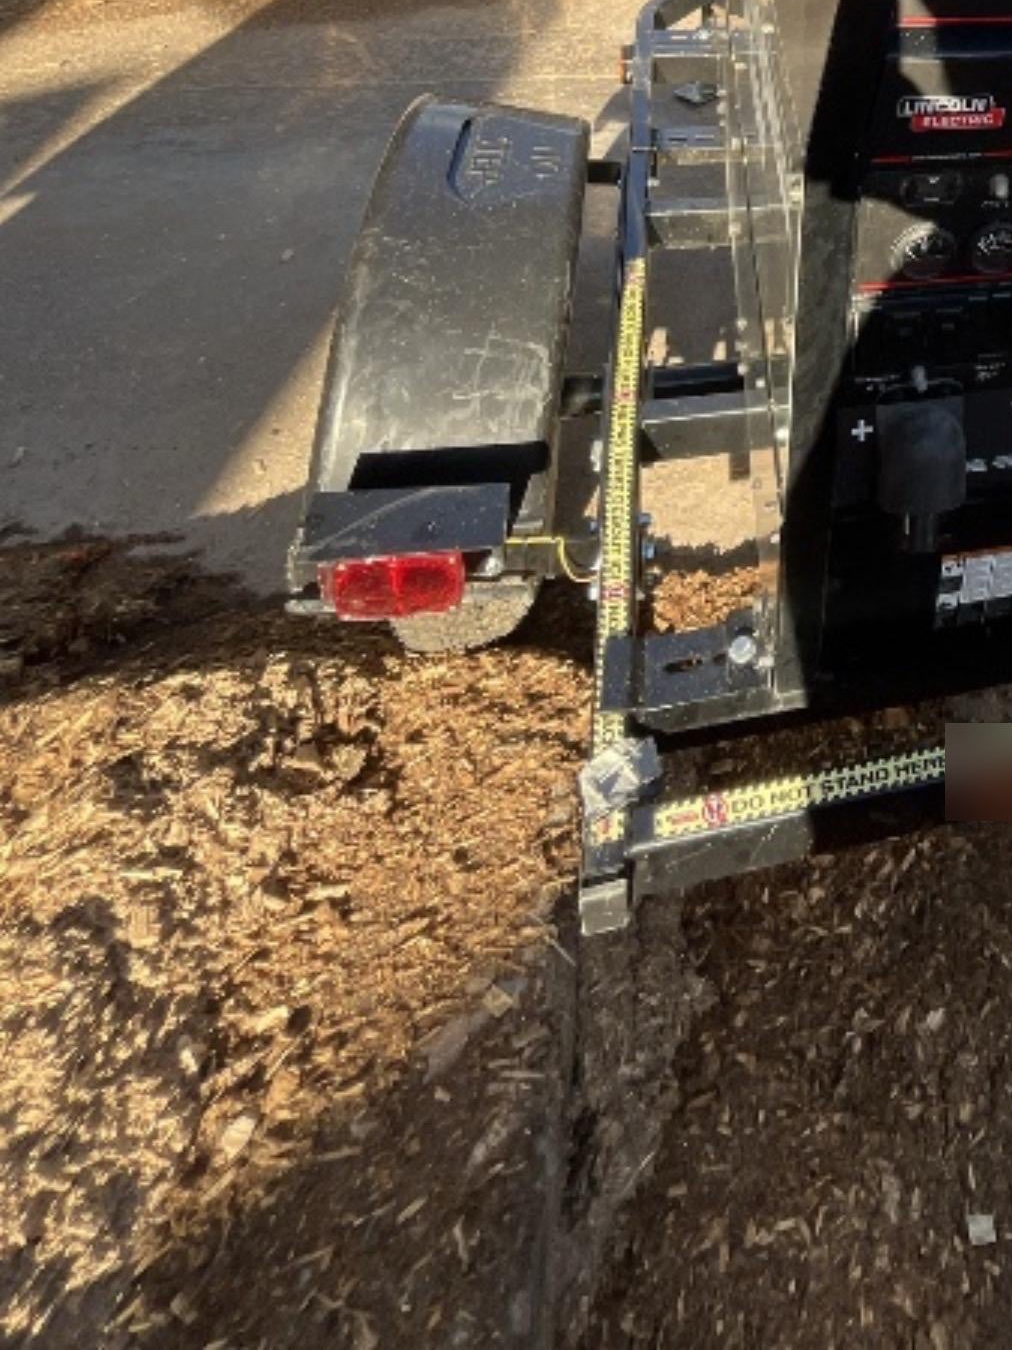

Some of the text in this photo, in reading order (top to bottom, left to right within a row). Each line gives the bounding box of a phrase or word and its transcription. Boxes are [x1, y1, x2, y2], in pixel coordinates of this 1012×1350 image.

[904, 97, 989, 115] LINCOLN
[922, 113, 994, 128] ELECTRIC
[732, 794, 763, 814] DO
[770, 784, 812, 804] NOT
[820, 768, 888, 795] STAND
